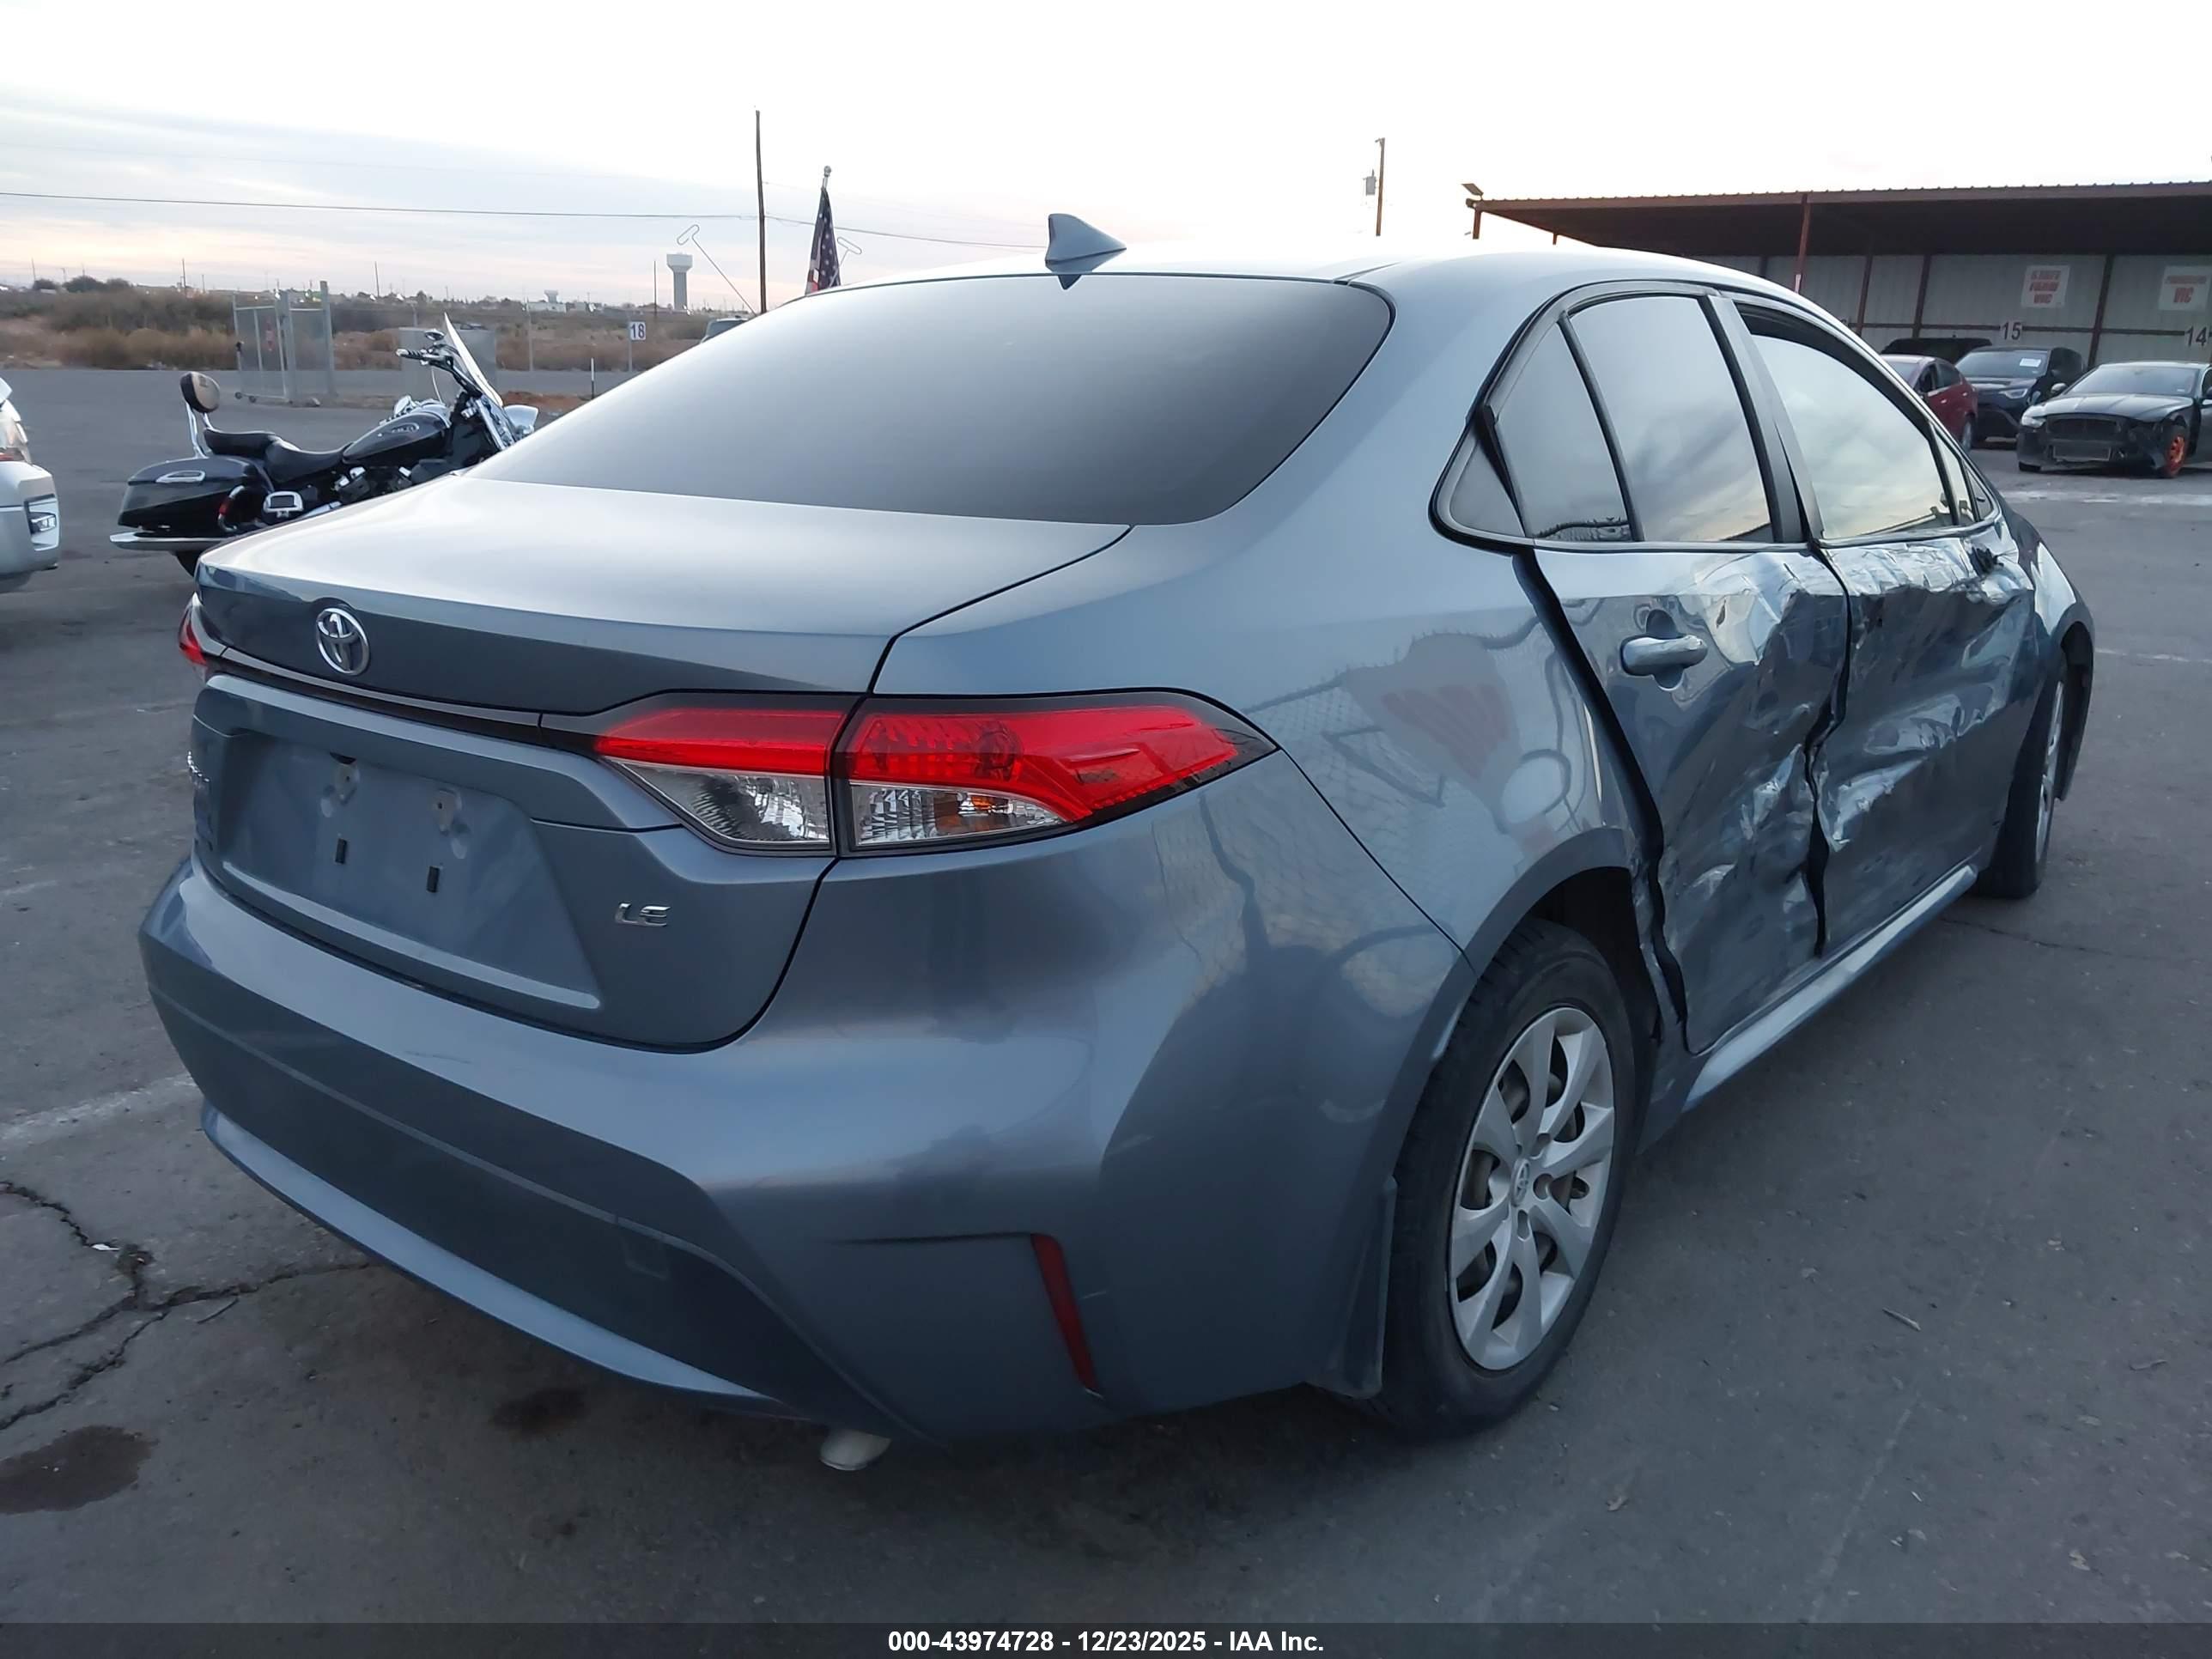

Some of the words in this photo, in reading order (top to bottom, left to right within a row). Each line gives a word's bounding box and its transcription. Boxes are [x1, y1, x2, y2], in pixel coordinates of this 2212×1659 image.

[631, 323, 645, 338] 18
[2002, 321, 2021, 340] 15
[2185, 325, 2207, 347] 14
[614, 902, 672, 928] LE
